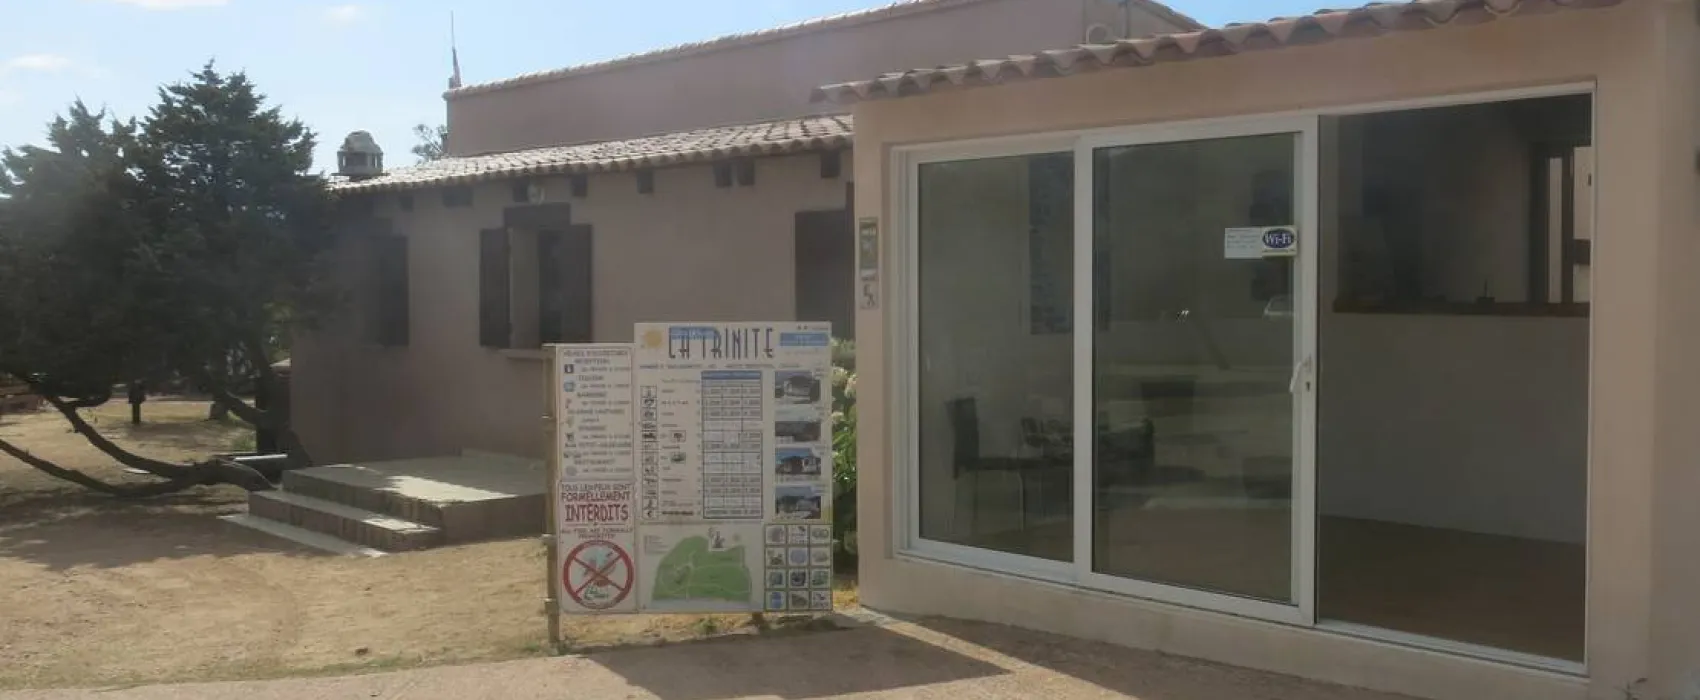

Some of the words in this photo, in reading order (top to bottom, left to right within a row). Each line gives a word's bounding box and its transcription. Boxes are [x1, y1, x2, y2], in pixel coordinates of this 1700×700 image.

[1264, 232, 1292, 244] Wi-Fi
[701, 327, 775, 360] TRINITE
[561, 491, 631, 502] FORMELLEMENT
[565, 504, 629, 522] INTERDITS
